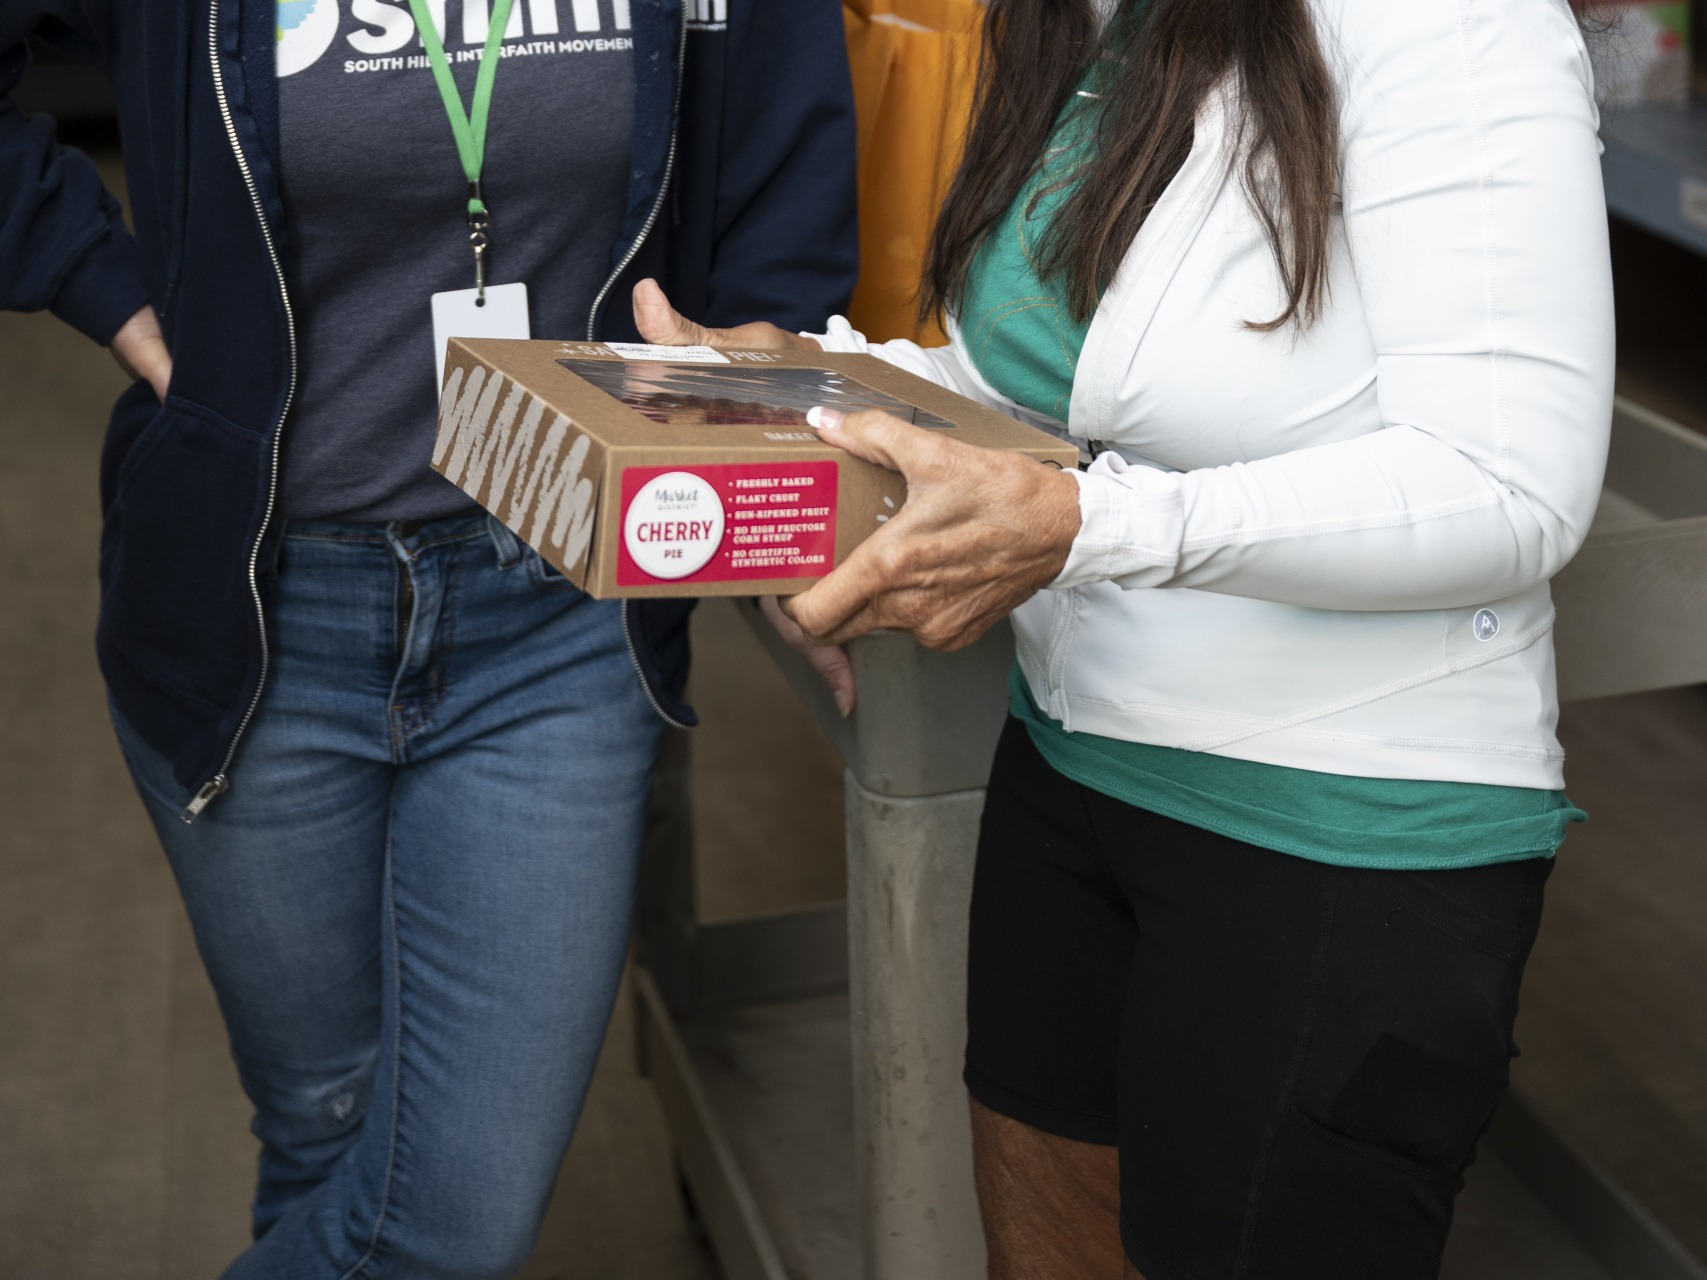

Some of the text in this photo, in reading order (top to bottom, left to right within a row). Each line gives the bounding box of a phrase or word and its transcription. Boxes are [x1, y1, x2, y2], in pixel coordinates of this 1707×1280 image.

[344, 37, 633, 74] SOUTH HILS INTRFAITH MOVEMEN
[726, 351, 776, 362] PIE!
[736, 476, 815, 488] FRESHLY BAKED
[655, 487, 699, 502] Market
[735, 492, 800, 504] FLAKY CRUST
[734, 507, 830, 520] SUN-RIPENED FRUIT
[637, 520, 713, 543] CHERRY
[734, 522, 826, 535] NO HIGH FRUCTOSE
[733, 533, 793, 545] CORN SYRUP
[664, 548, 683, 559] PIE
[732, 547, 800, 559] NO CERTIFIED
[731, 554, 825, 568] SYNTHETIC COLORS
